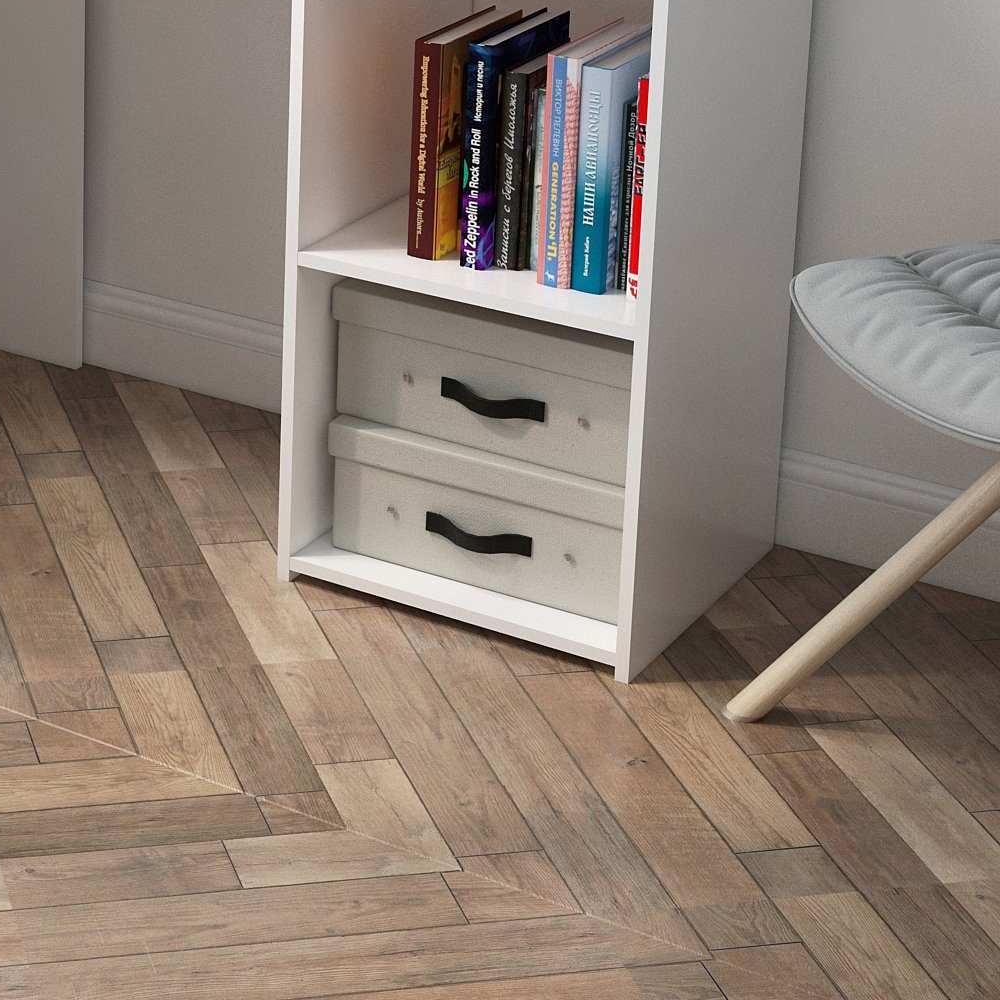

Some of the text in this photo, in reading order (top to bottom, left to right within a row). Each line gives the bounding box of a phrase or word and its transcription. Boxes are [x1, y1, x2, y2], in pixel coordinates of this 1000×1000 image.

[420, 55, 430, 98] Empowering
[477, 61, 485, 82] песни
[474, 88, 485, 122] История
[552, 79, 563, 158] ВИКТОР ПЕЛЕВИН
[628, 112, 637, 139] Дозор
[417, 149, 427, 172] Digital
[582, 90, 603, 227] НАШИ АВИАНОСЦЫ
[626, 140, 635, 172] Ночной
[418, 173, 426, 194] World
[502, 153, 515, 200] берегов
[463, 128, 481, 271] Led Zeppelin in Rock and Roll
[504, 204, 511, 213] с
[549, 162, 559, 240] GENERATION
[496, 219, 510, 270] Записки
